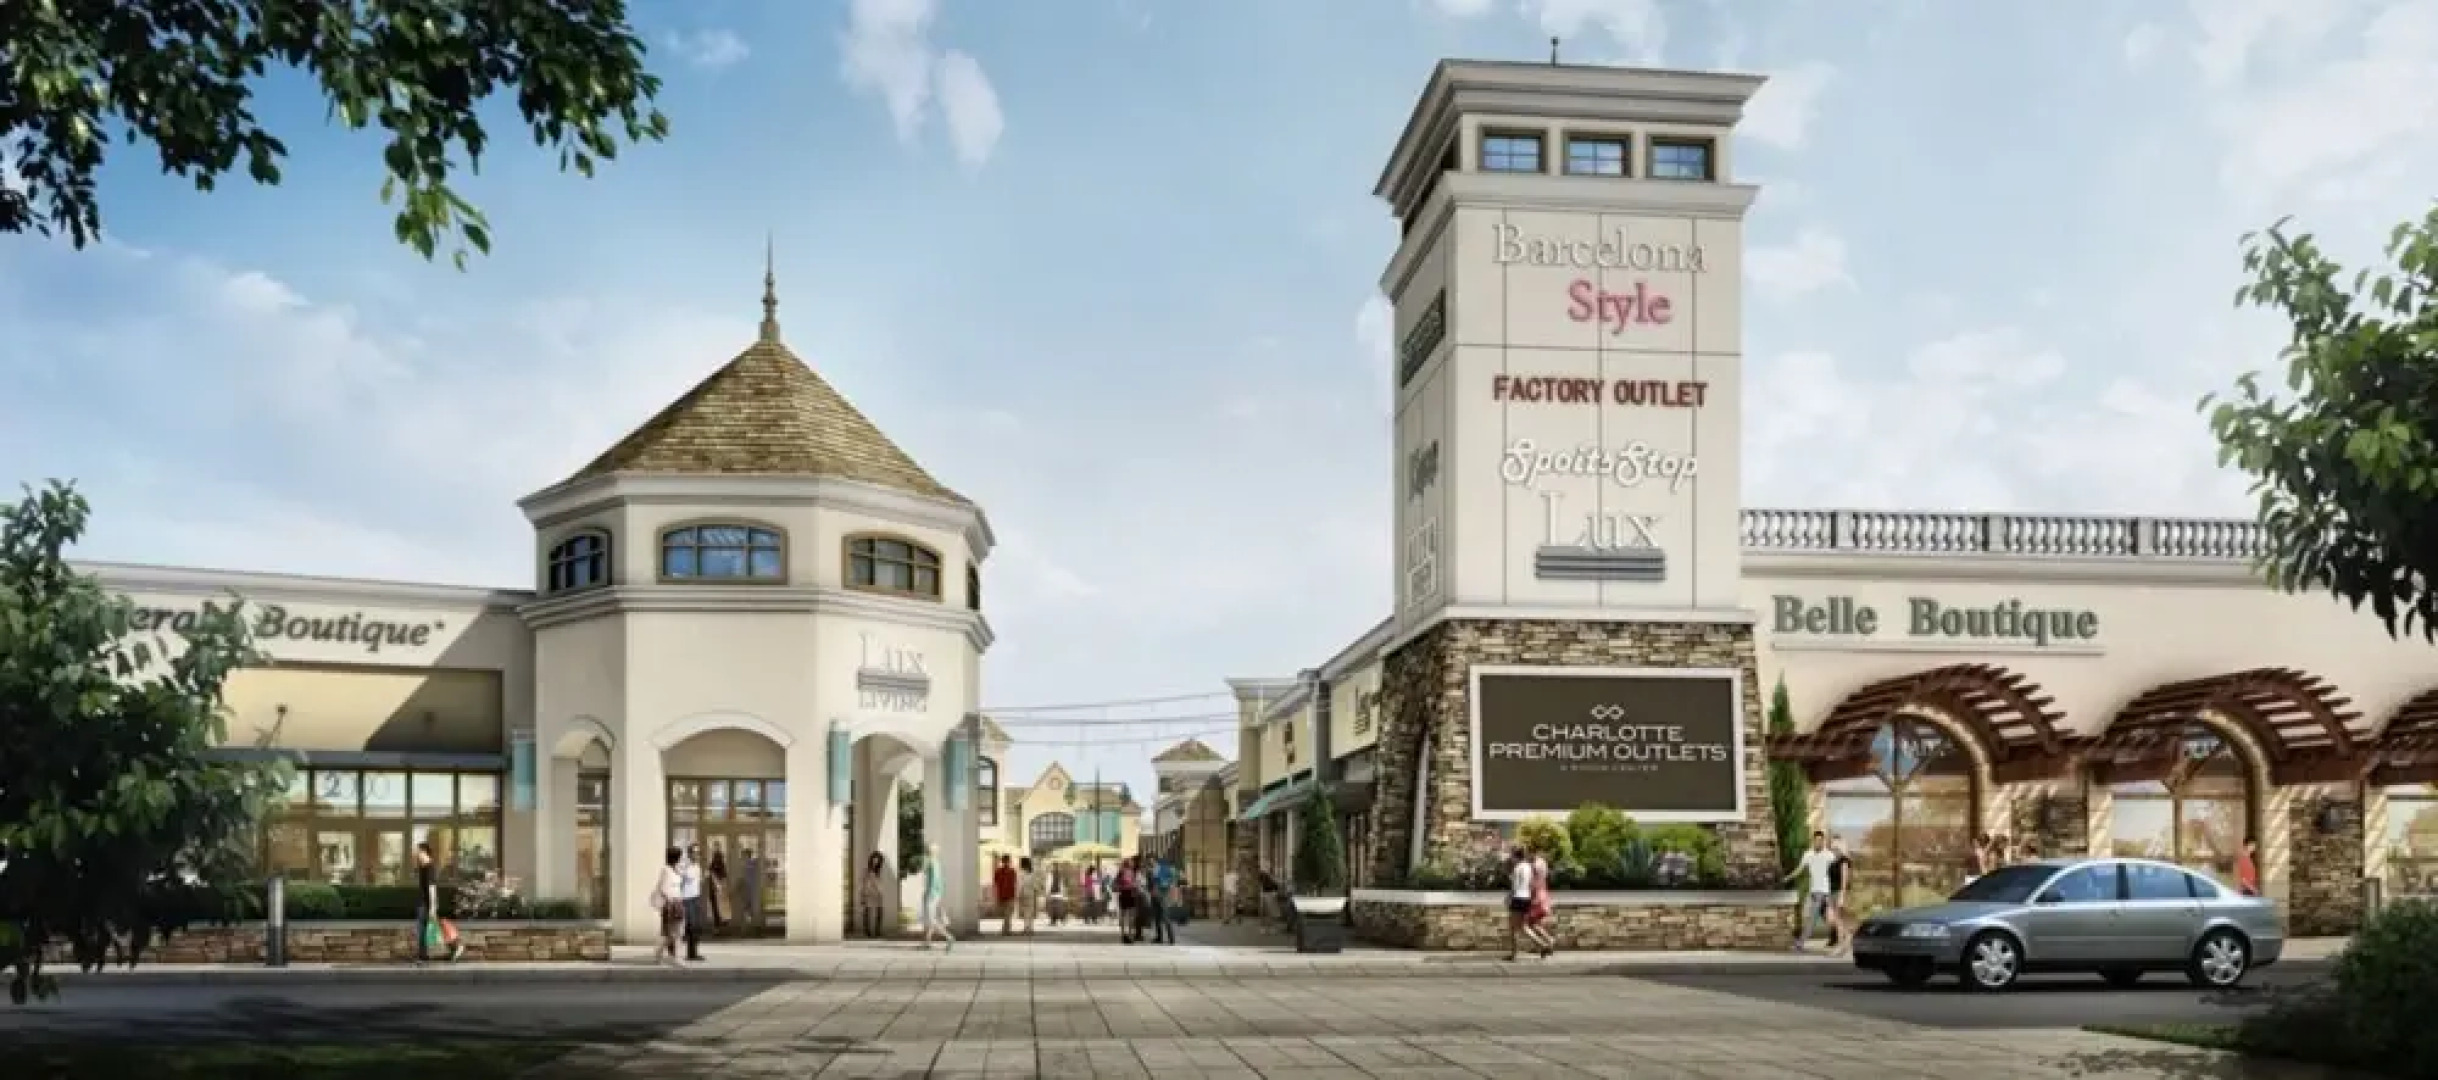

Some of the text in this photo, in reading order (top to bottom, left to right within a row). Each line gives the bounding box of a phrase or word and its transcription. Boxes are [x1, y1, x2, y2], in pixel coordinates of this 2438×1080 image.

[1491, 222, 1707, 273] Barcelona
[1567, 278, 1673, 336] Style
[1492, 374, 1709, 408] FACTORY OUTLET
[1771, 594, 2099, 647] Belle Boutique
[1488, 743, 1728, 762] PREMIUM OUTLETS
[1531, 723, 1685, 742] CHARLOTTE
